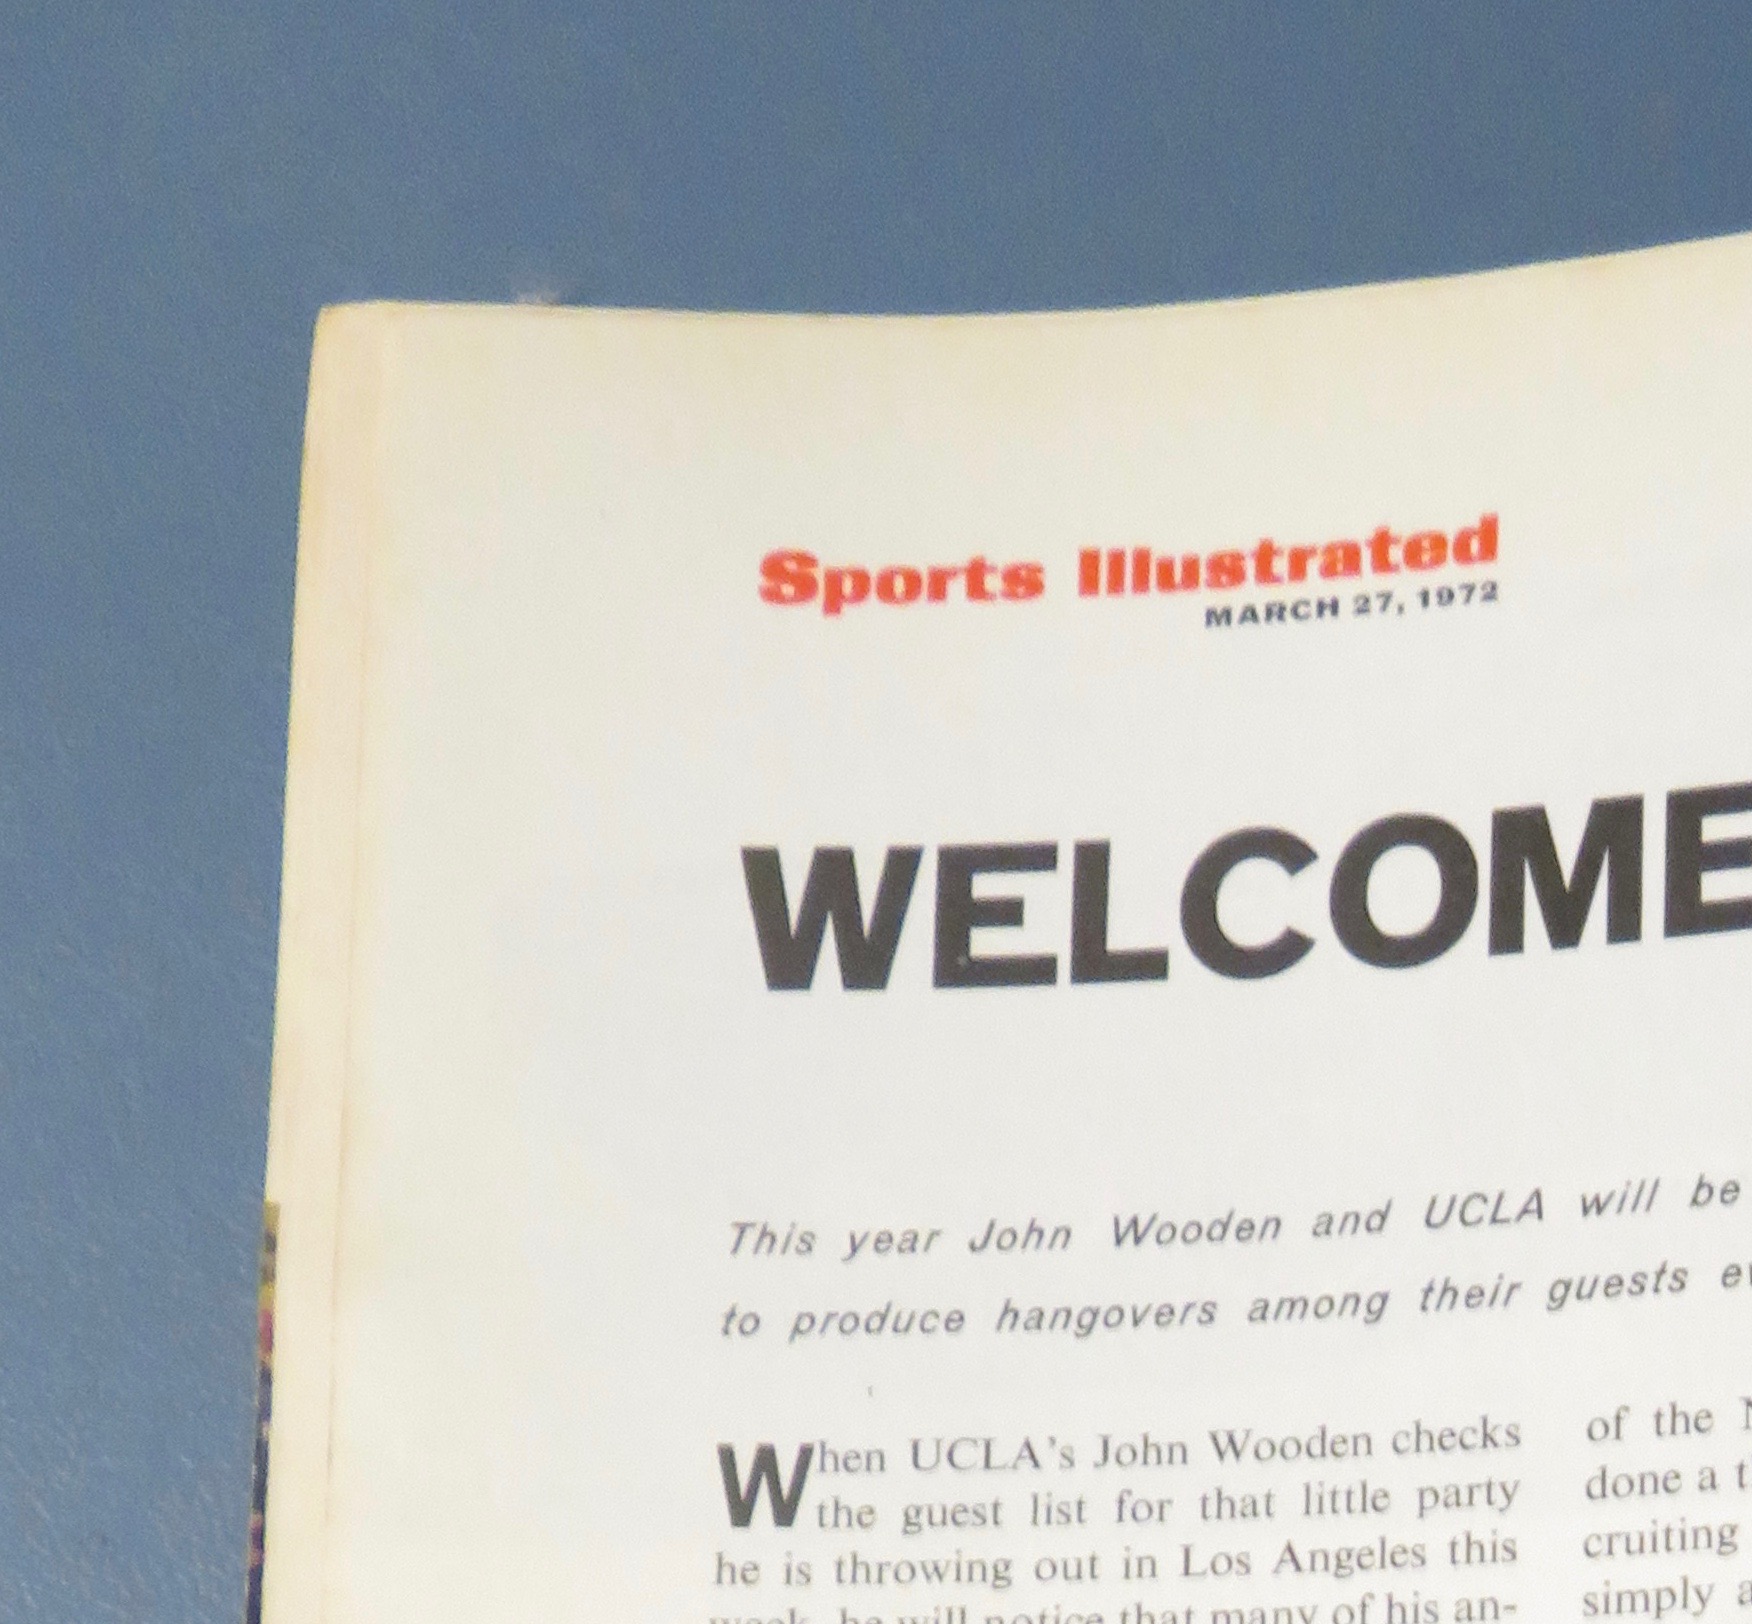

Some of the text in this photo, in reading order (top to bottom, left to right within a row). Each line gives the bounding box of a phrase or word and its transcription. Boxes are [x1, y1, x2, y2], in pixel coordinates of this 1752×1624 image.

[758, 512, 1499, 618] Sports Illustrated
[1204, 580, 1499, 629] MARCH 27, 1972
[731, 1222, 815, 1255] This
[843, 1230, 940, 1262] year
[969, 1218, 1071, 1253] John
[1113, 1210, 1282, 1248] Wooden
[1312, 1200, 1392, 1237] and
[1424, 1188, 1543, 1229] UCLA
[1581, 1179, 1659, 1218] will
[1690, 1174, 1741, 1207] be
[722, 1306, 761, 1336] to
[789, 1302, 965, 1342] produce
[996, 1299, 1217, 1338] hangovers
[1248, 1292, 1389, 1325] among
[1420, 1274, 1521, 1312] their
[1547, 1262, 1688, 1312] guests
[717, 1440, 886, 1528] When
[1094, 1433, 1188, 1469] John
[1209, 1425, 1373, 1463] Wooden
[1391, 1415, 1521, 1456] checks
[1585, 1465, 1681, 1501] done
[1698, 1467, 1718, 1493] a
[817, 1479, 1519, 1536] the guest list for that little party
[1583, 1576, 1713, 1620] simply
